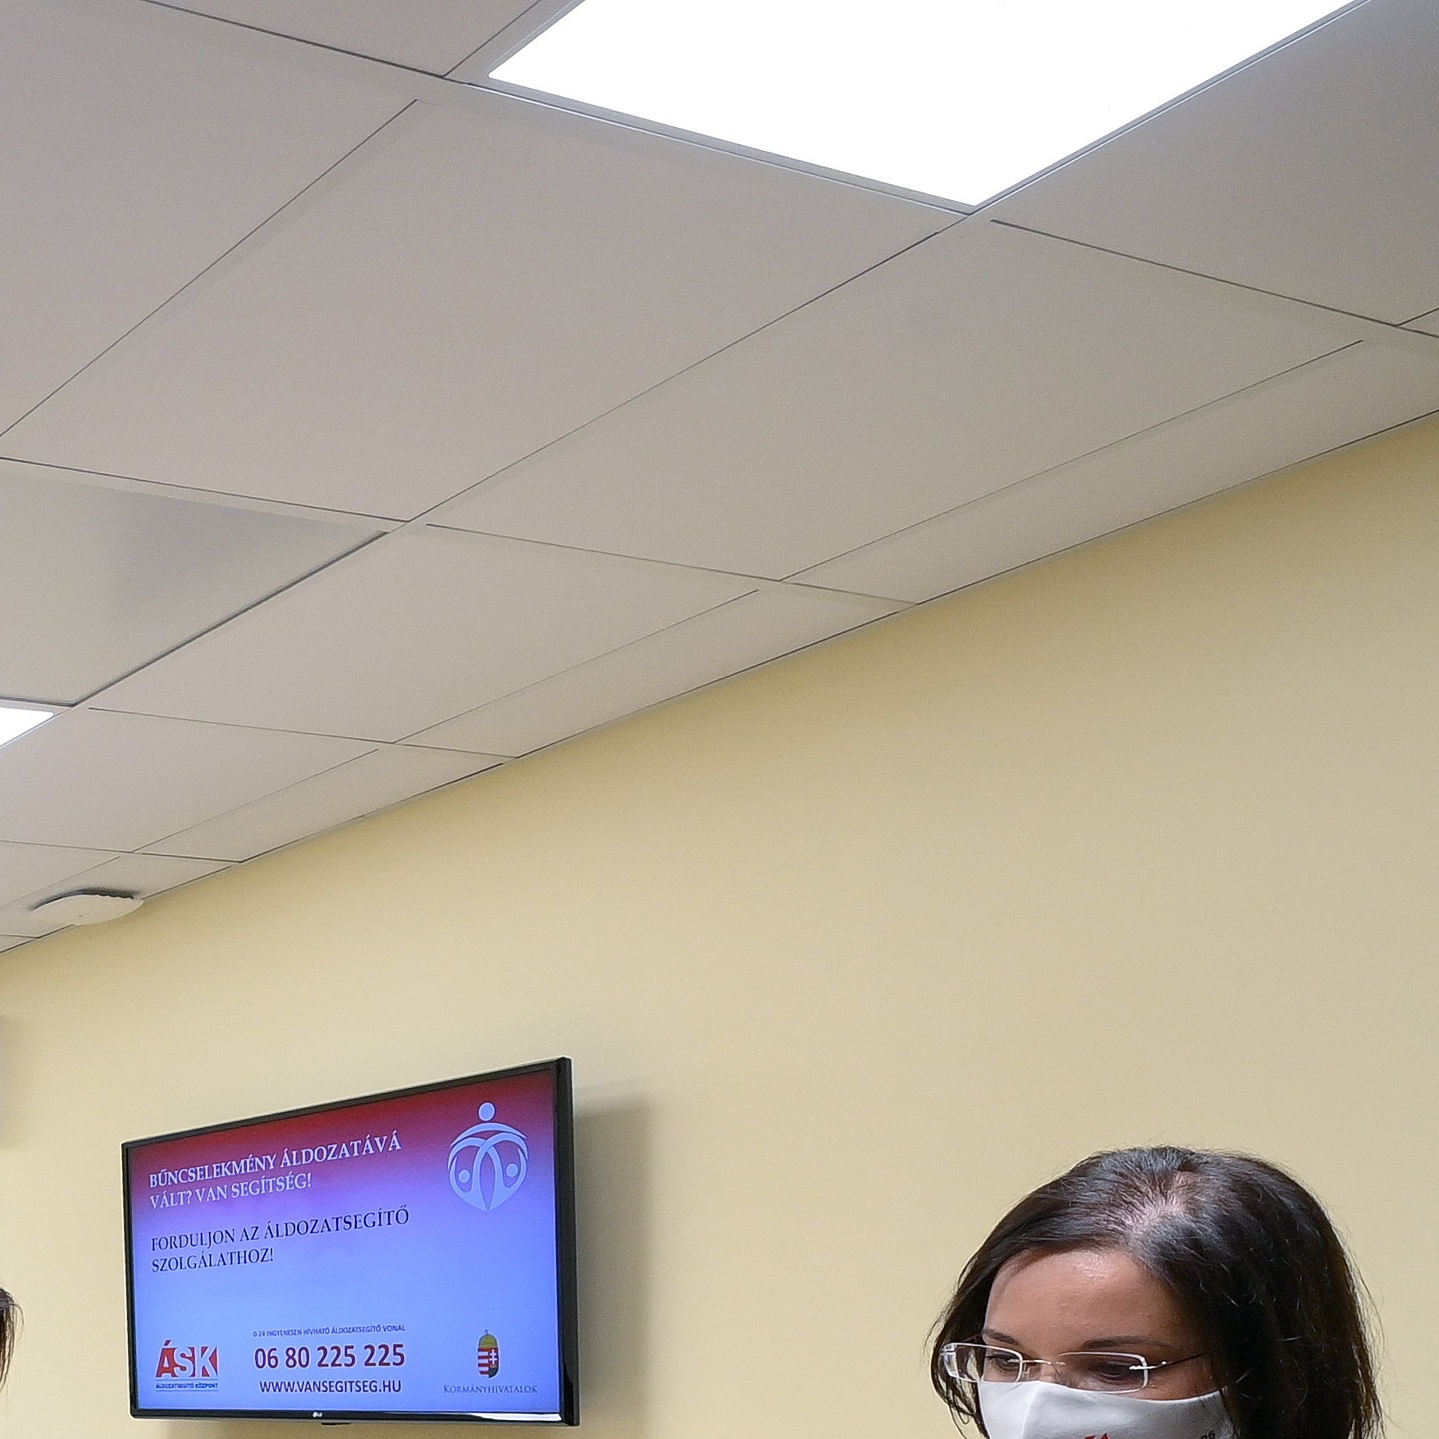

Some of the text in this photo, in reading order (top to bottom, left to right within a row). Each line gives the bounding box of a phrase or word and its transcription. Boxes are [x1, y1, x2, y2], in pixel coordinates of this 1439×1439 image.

[150, 1130, 401, 1188] BŰNCSELEKMÉNY ÁLDOZATÁVÁ
[150, 1172, 312, 1209] VÁLT? VAN SEGÍTSÉG!
[151, 1206, 409, 1251] FORDULJON AZ ÁLDOZATSEGÍTŐ
[151, 1247, 274, 1273] SZOLGÁLATHOZ!
[155, 1340, 219, 1378] ÁSK
[254, 1343, 406, 1369] 06 80 225 225
[259, 1380, 402, 1394] WWW.VANSEGITSEG.HU
